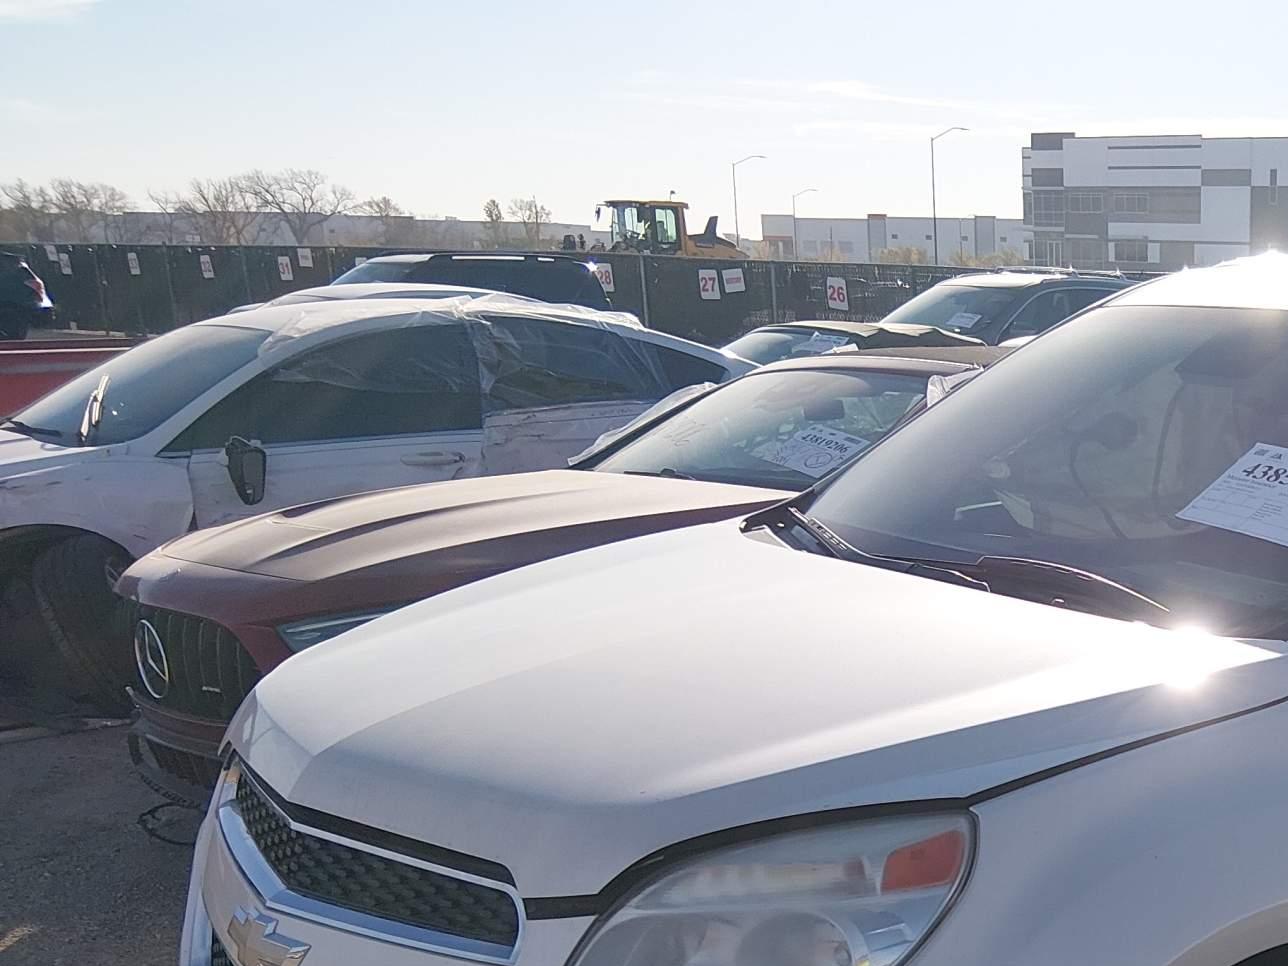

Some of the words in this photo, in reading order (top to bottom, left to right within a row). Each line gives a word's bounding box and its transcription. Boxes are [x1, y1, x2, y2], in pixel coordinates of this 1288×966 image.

[278, 262, 290, 276] 31
[597, 270, 612, 285] 28
[700, 276, 717, 293] 27
[828, 285, 846, 303] 26
